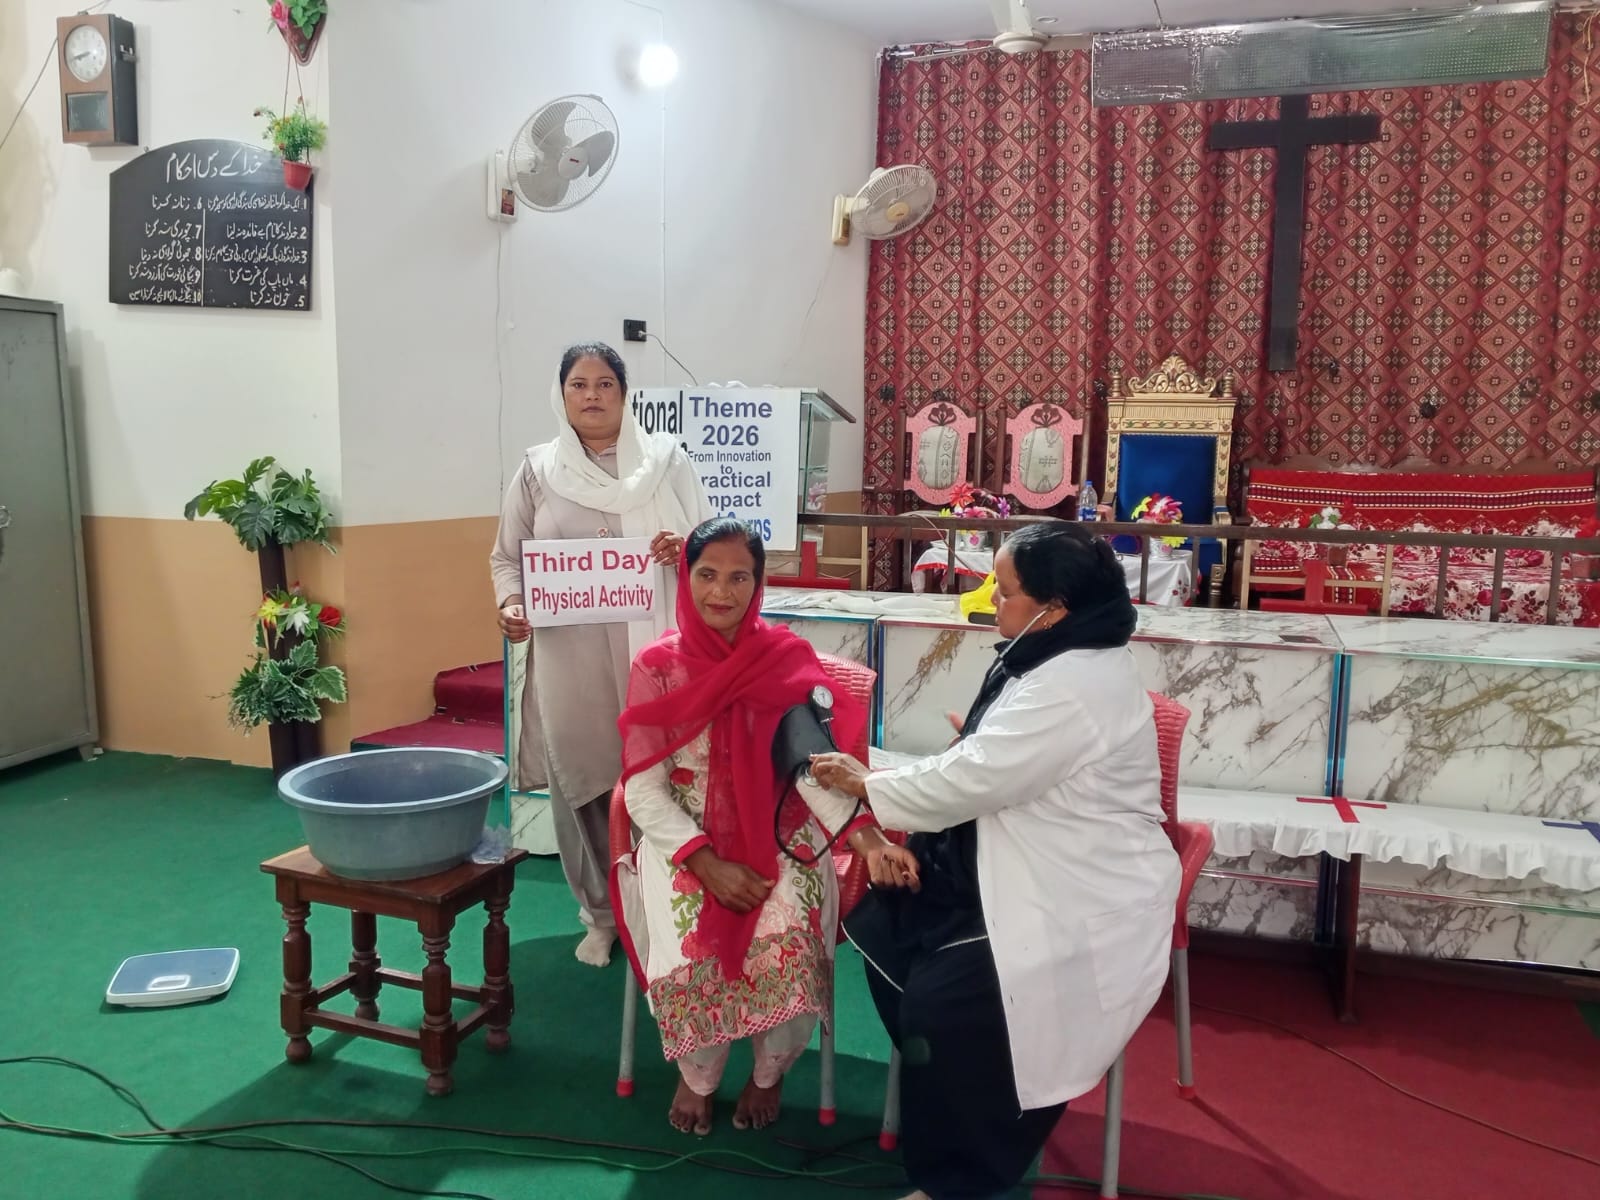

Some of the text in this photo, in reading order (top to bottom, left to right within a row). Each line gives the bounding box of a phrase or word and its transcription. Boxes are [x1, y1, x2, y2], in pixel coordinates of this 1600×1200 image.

[166, 152, 196, 183] احکام
[219, 147, 242, 176] کے
[241, 151, 263, 176] خدا
[152, 193, 172, 210] کرنا
[145, 219, 159, 238] کرنا
[158, 222, 172, 235] نہ
[170, 219, 192, 243] چوری
[129, 262, 142, 280] کرنا
[229, 267, 243, 284] کرنا
[250, 284, 268, 305] کرنا
[273, 288, 290, 306] خون
[689, 396, 773, 418] Theme
[702, 425, 759, 446] 2026
[688, 450, 771, 462] From Innovation
[701, 471, 771, 488] ractical
[720, 464, 733, 475] to
[524, 550, 650, 574] Third Day
[532, 583, 653, 615] Physical Activity
